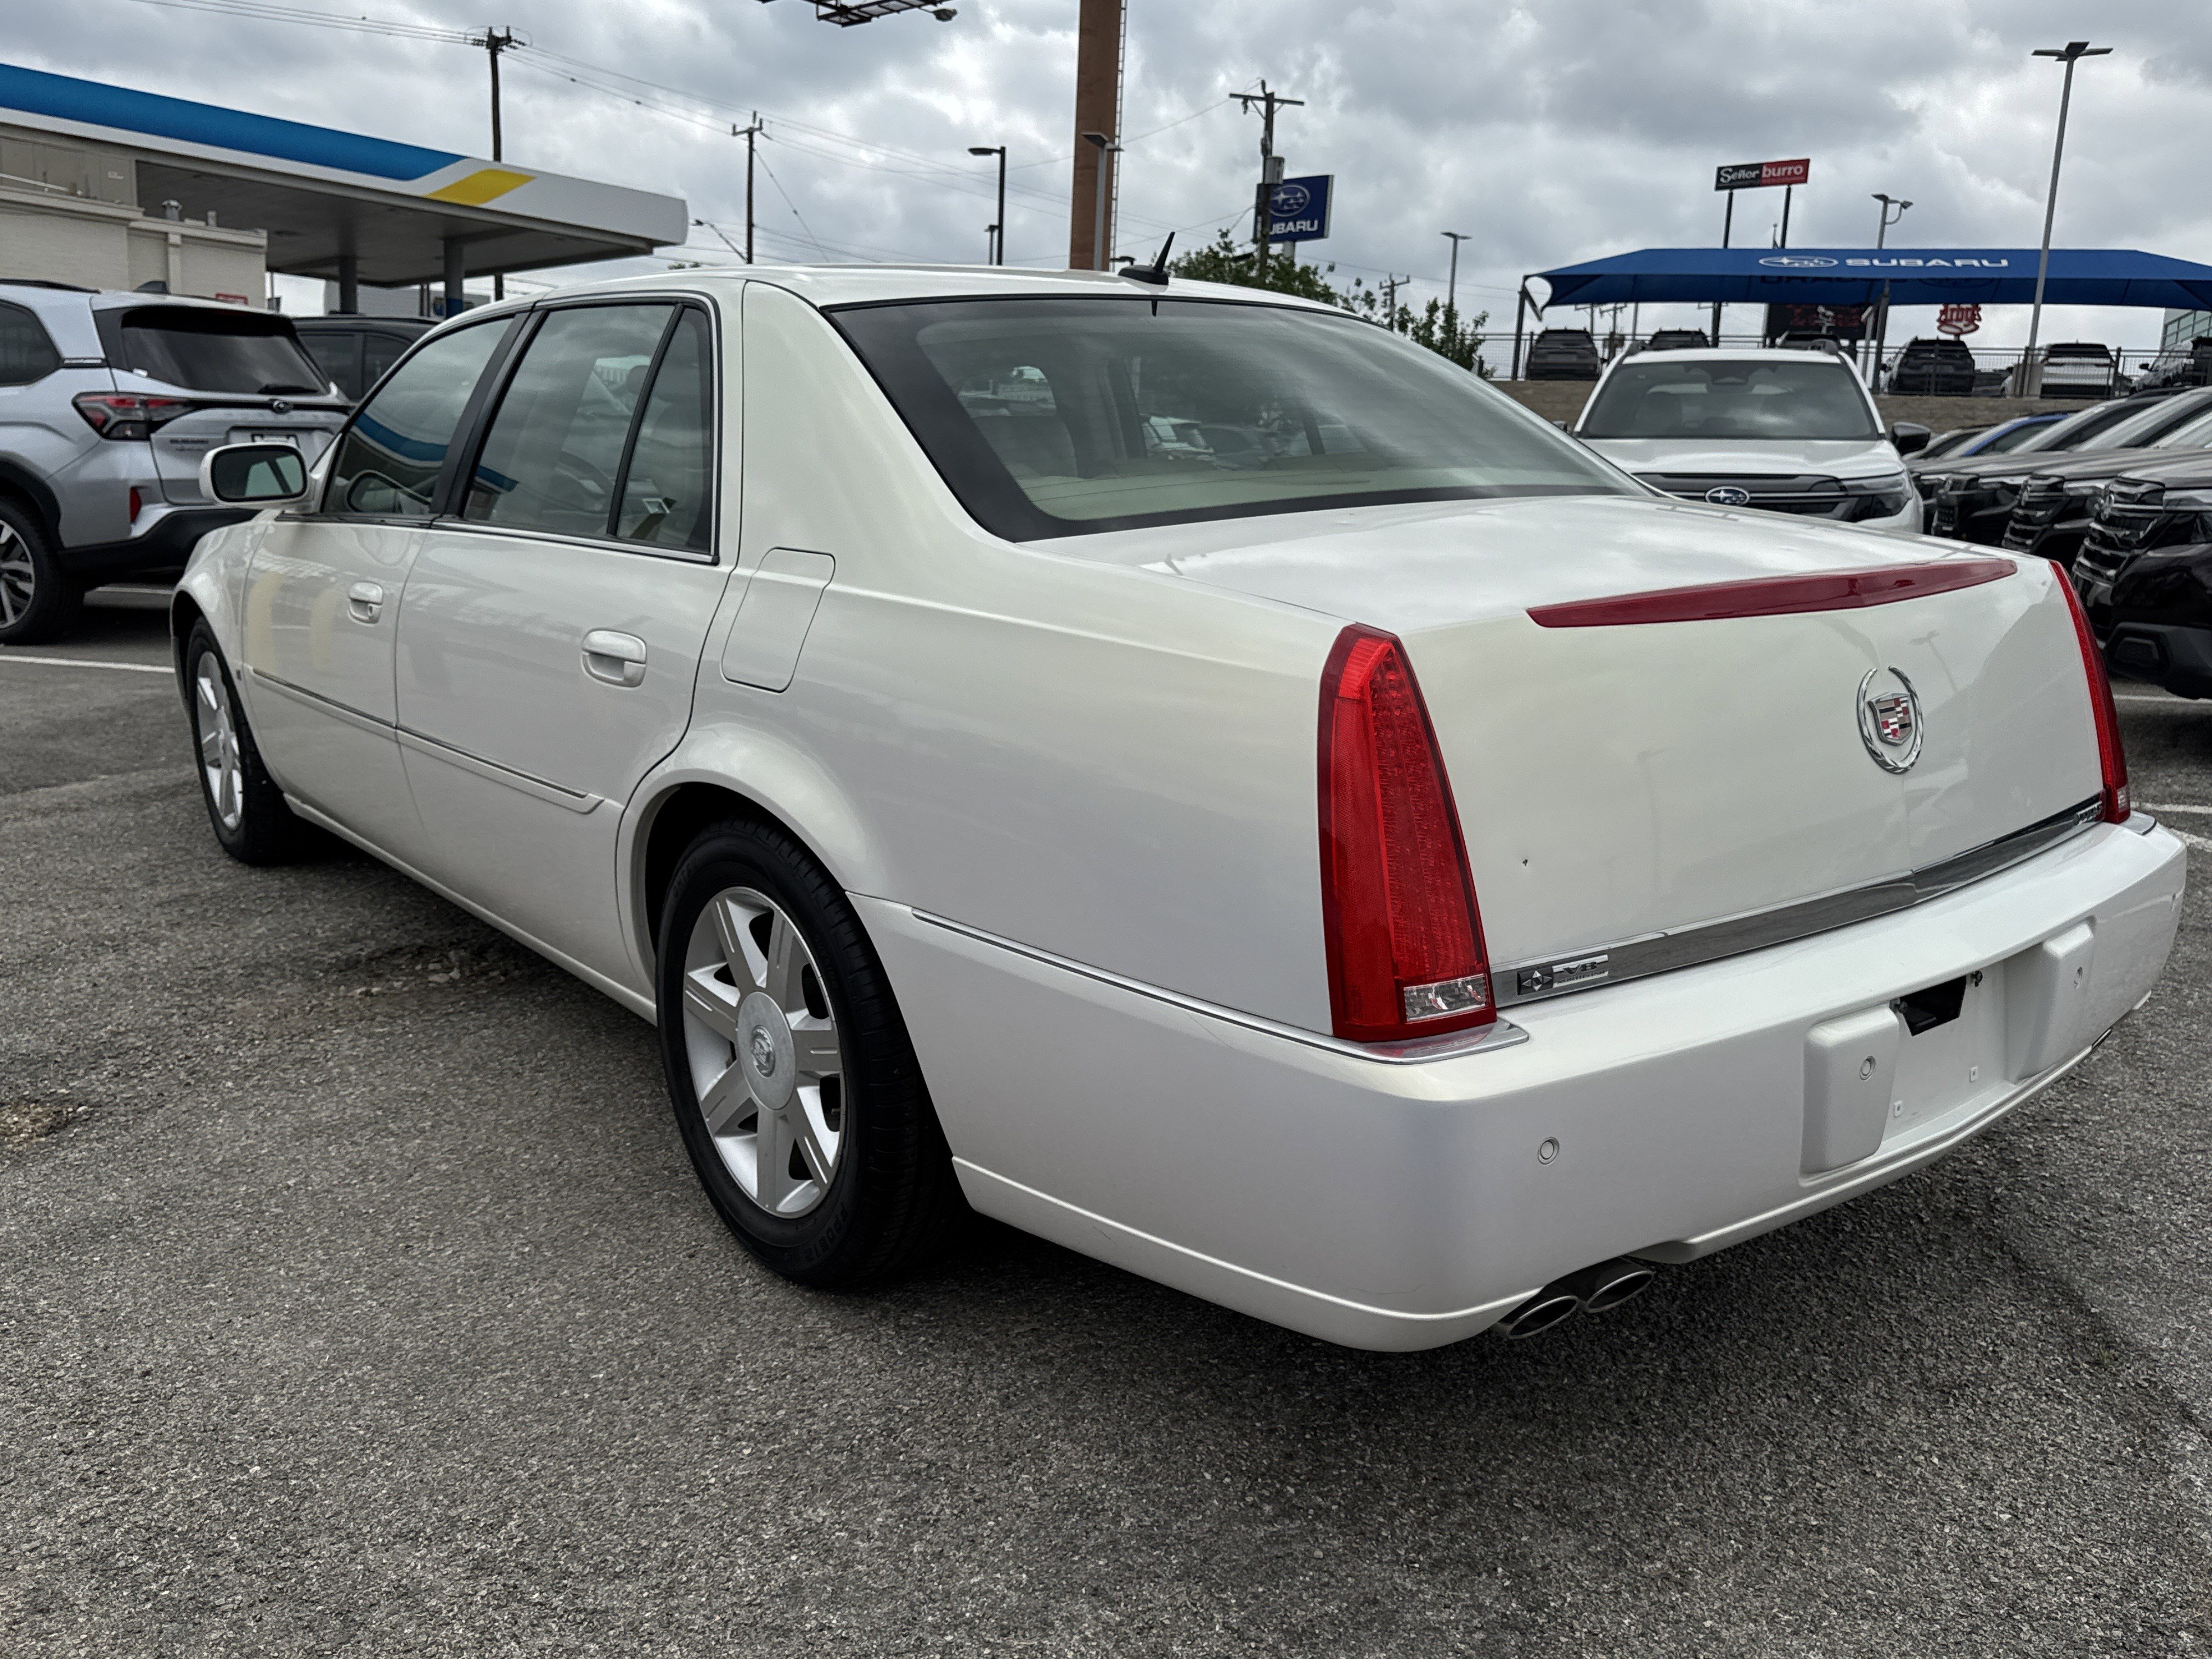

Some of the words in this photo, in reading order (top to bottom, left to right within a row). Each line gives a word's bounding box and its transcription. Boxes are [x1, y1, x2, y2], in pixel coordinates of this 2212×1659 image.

[1760, 165, 1804, 178] burro
[1844, 258, 2009, 267] SUBARU
[1562, 962, 1598, 975] V8
